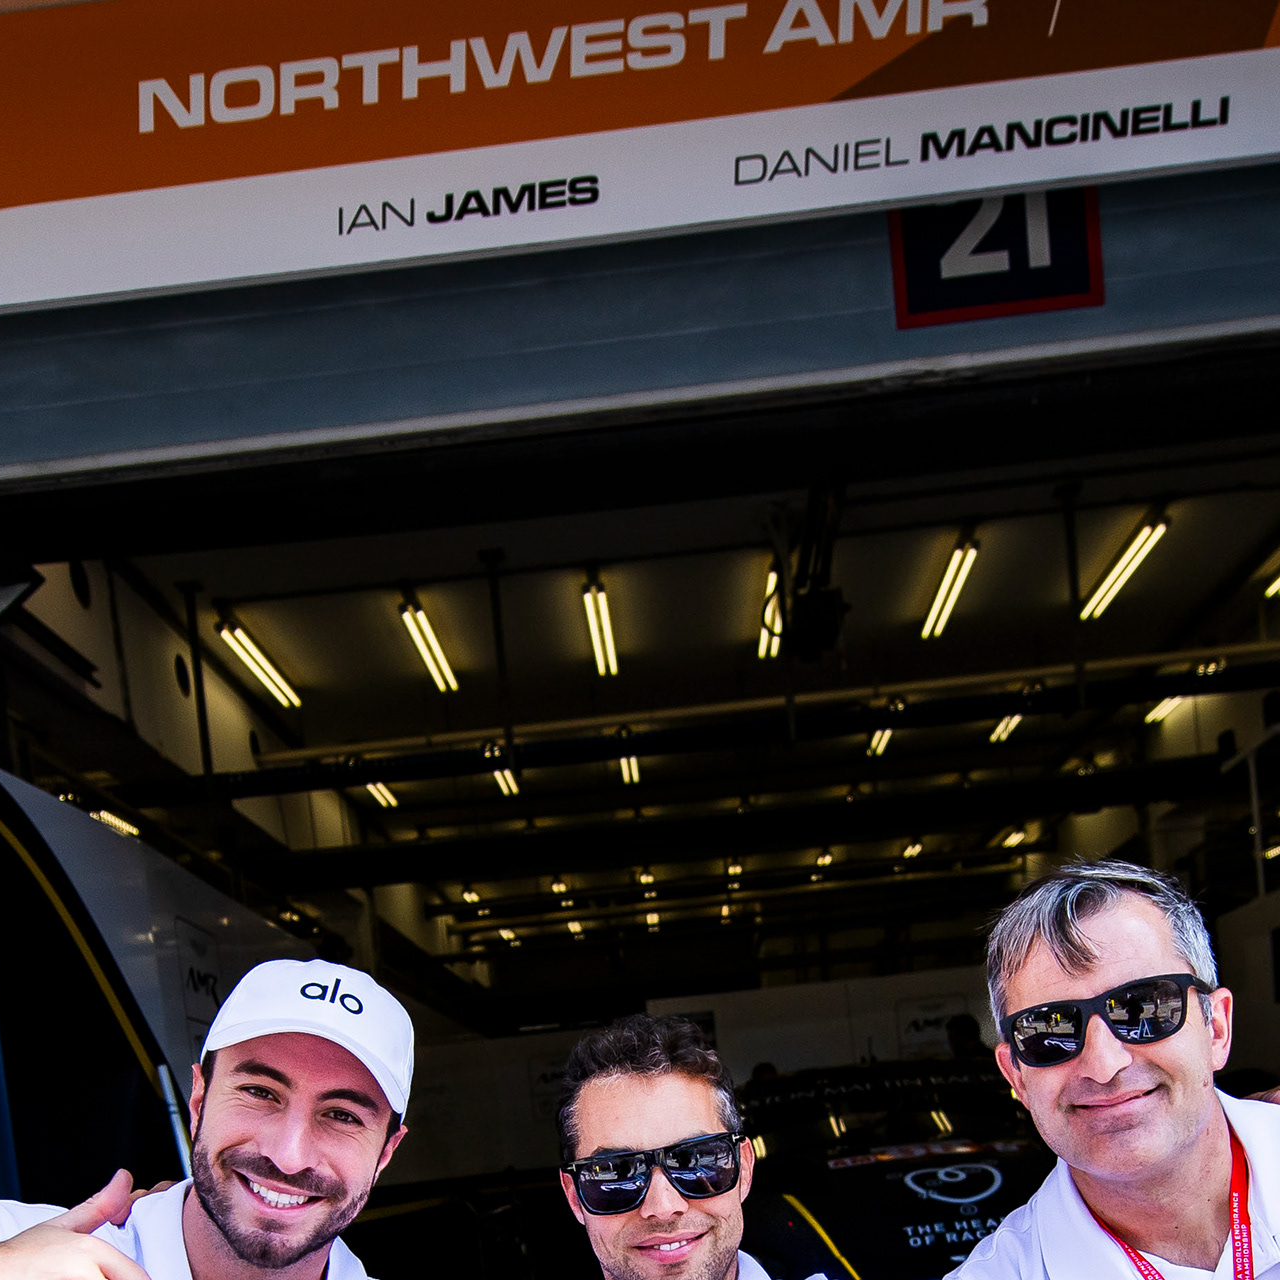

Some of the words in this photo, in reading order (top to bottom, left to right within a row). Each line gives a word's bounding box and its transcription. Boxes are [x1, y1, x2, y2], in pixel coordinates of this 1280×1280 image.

[138, 3, 749, 133] NORTHWEST
[732, 137, 910, 187] DANIEL
[918, 96, 1232, 164] MANCINELLI
[337, 198, 416, 237] IAN
[425, 174, 601, 226] JAMES
[938, 188, 1053, 280] 21
[299, 977, 364, 1015] alo
[902, 1222, 947, 1237] THE
[954, 1216, 1005, 1231] HEA
[908, 1234, 936, 1248] OF
[945, 1229, 995, 1243] RAC
[1232, 1192, 1241, 1239] ENDURANCE
[1234, 1240, 1243, 1275] WORLD
